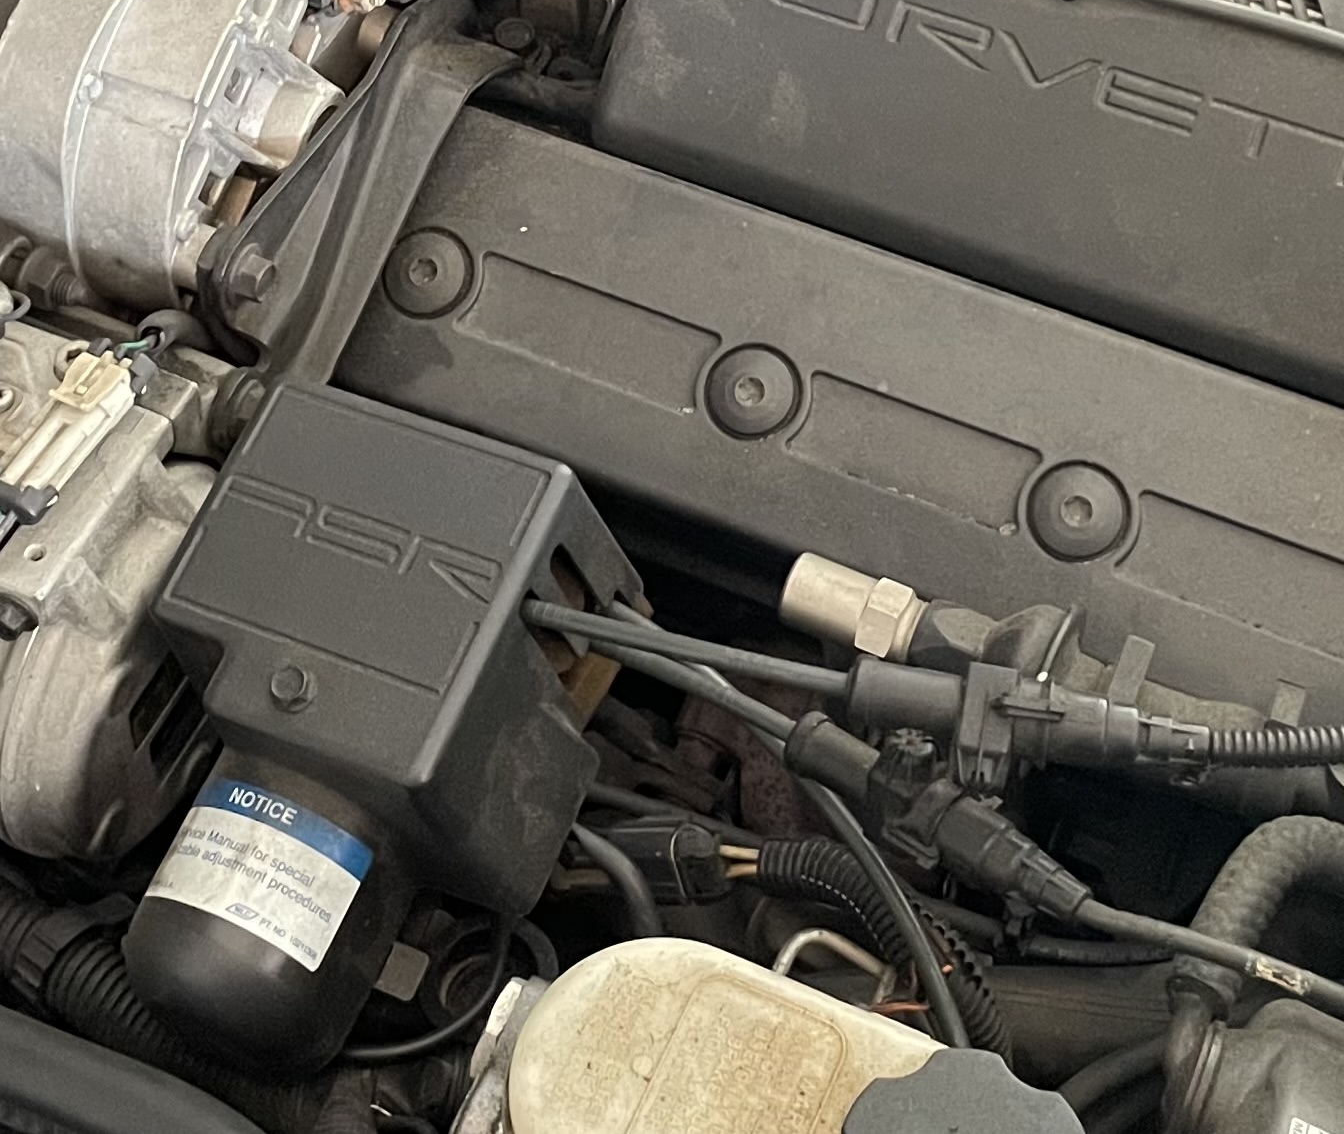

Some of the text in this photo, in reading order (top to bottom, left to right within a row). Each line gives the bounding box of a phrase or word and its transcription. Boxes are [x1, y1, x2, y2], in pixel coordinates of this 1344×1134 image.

[209, 473, 503, 605] ASR
[228, 786, 298, 826] NOTICE
[202, 849, 268, 883] adjustment
[266, 877, 332, 924] procedures
[207, 829, 250, 854] Manual
[250, 846, 270, 863] for
[269, 857, 316, 888] special
